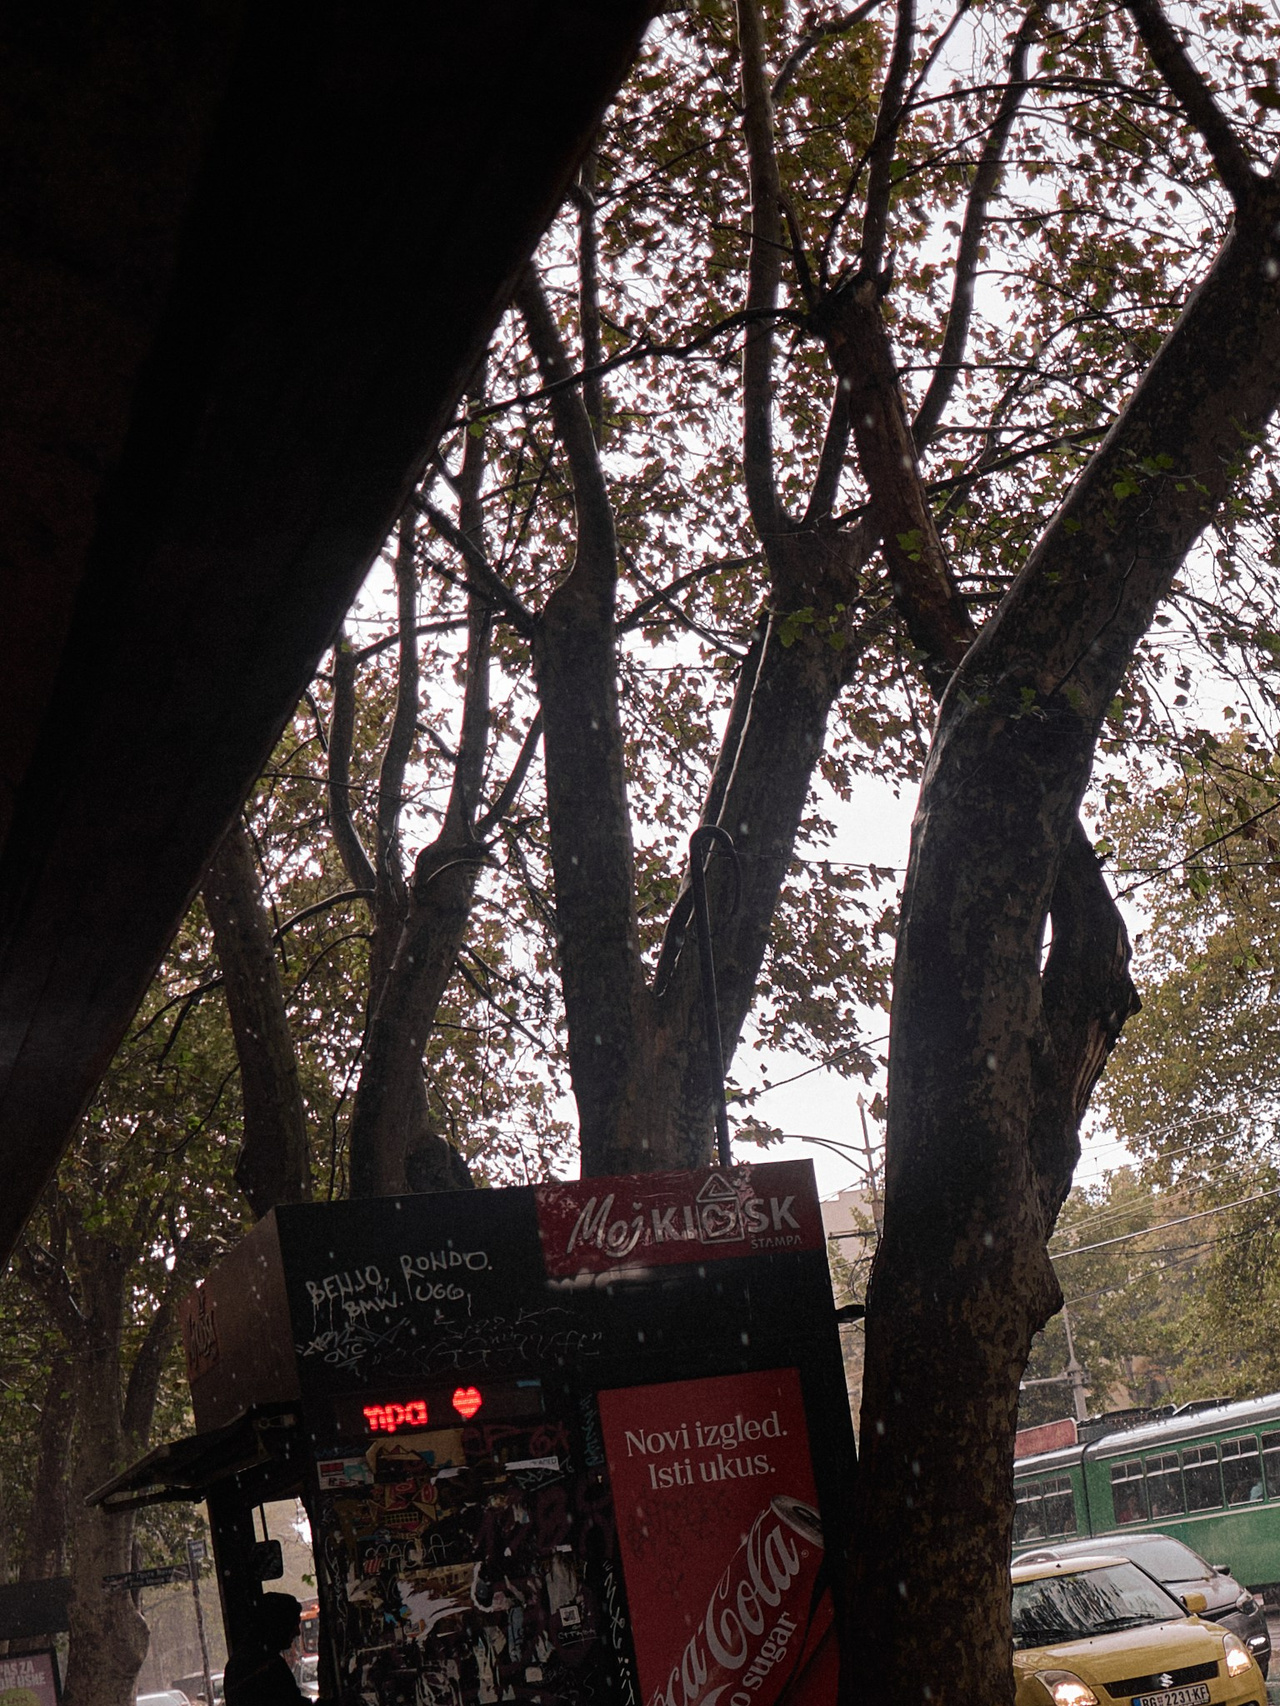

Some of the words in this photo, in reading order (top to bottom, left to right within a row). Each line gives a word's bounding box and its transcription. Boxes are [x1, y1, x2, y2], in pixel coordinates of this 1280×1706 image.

[750, 1233, 804, 1250] ŠTAMPA
[624, 1423, 691, 1457] Novi
[695, 1411, 788, 1450] izgled.
[648, 1458, 695, 1490] Isti
[699, 1453, 776, 1482] ukus.
[741, 1611, 799, 1691] sugar
